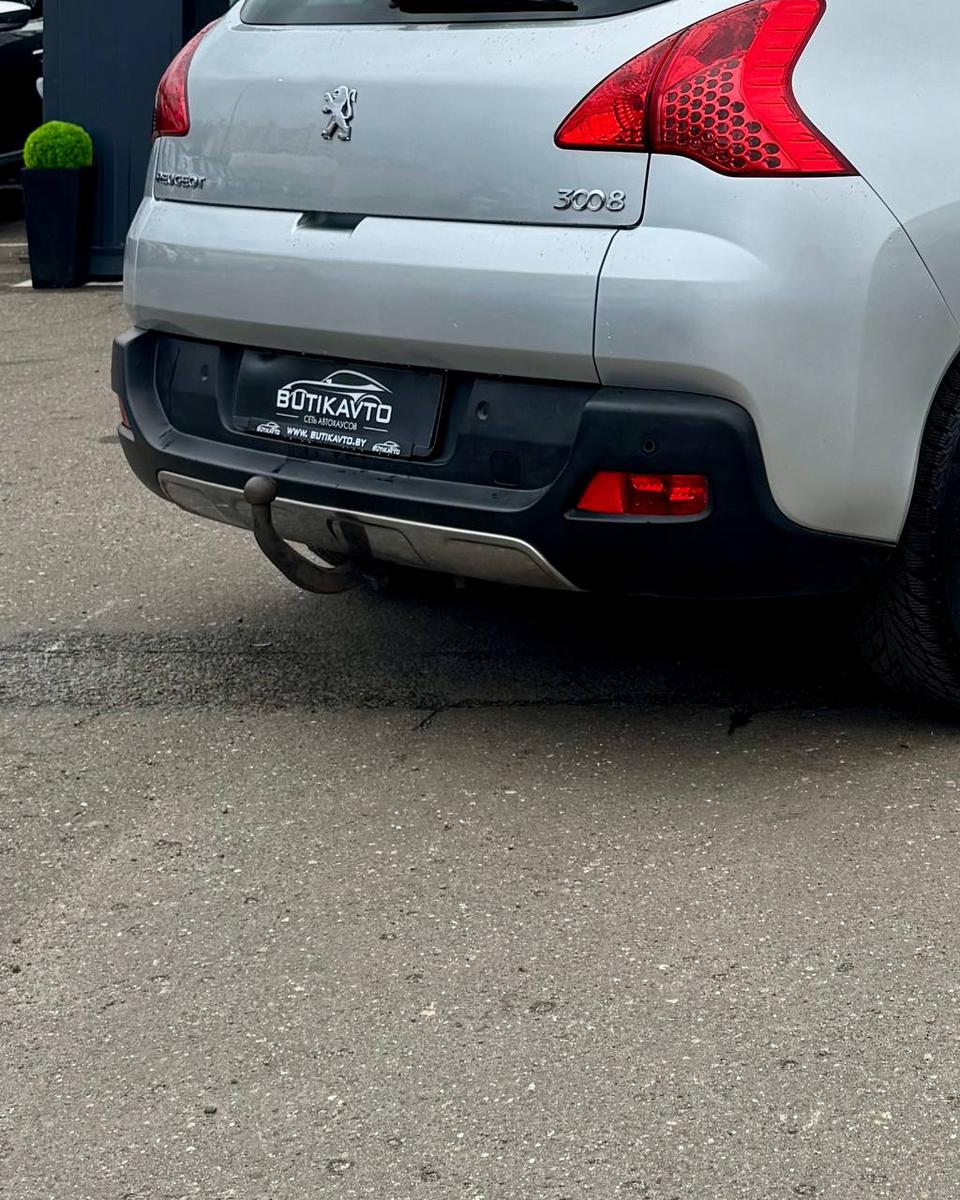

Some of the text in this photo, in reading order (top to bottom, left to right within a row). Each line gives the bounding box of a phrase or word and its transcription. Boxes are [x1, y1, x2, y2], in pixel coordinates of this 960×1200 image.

[553, 188, 626, 212] 3008
[276, 388, 393, 424] BUTIKAVTO
[287, 426, 367, 448] WWW. BUTIKAVTO.BY
